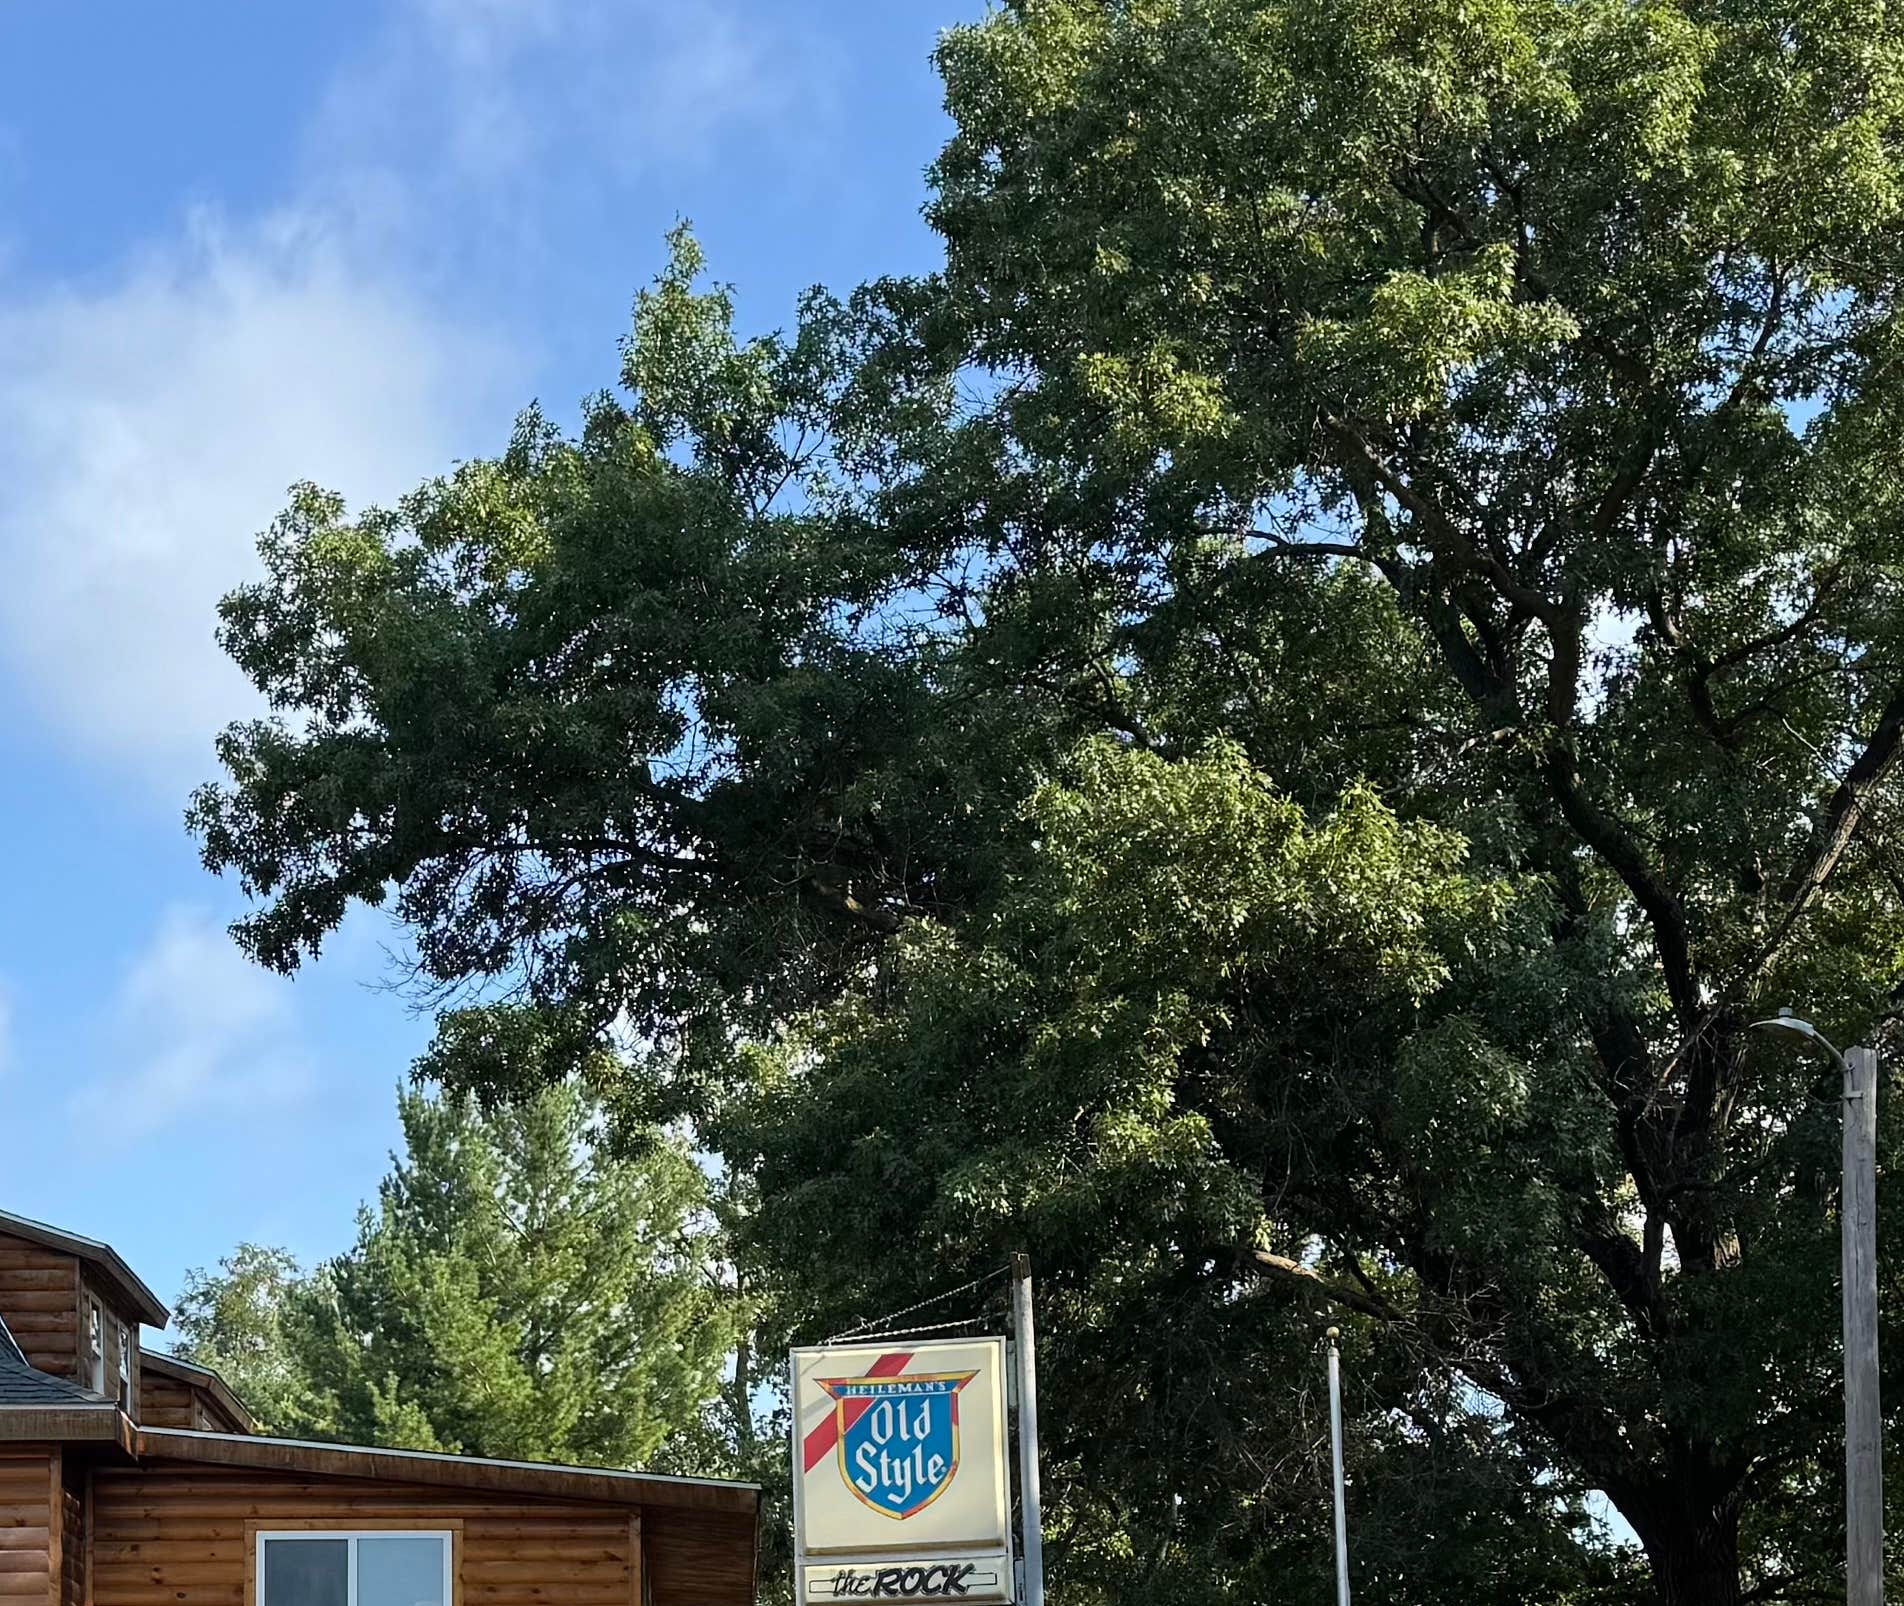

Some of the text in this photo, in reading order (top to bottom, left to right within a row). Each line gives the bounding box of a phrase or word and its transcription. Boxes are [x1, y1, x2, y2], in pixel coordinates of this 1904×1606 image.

[845, 1381, 947, 1396] HEILEMAN'S
[870, 1398, 932, 1445] Old
[855, 1441, 945, 1505] Style
[872, 1562, 977, 1598] ROCK
